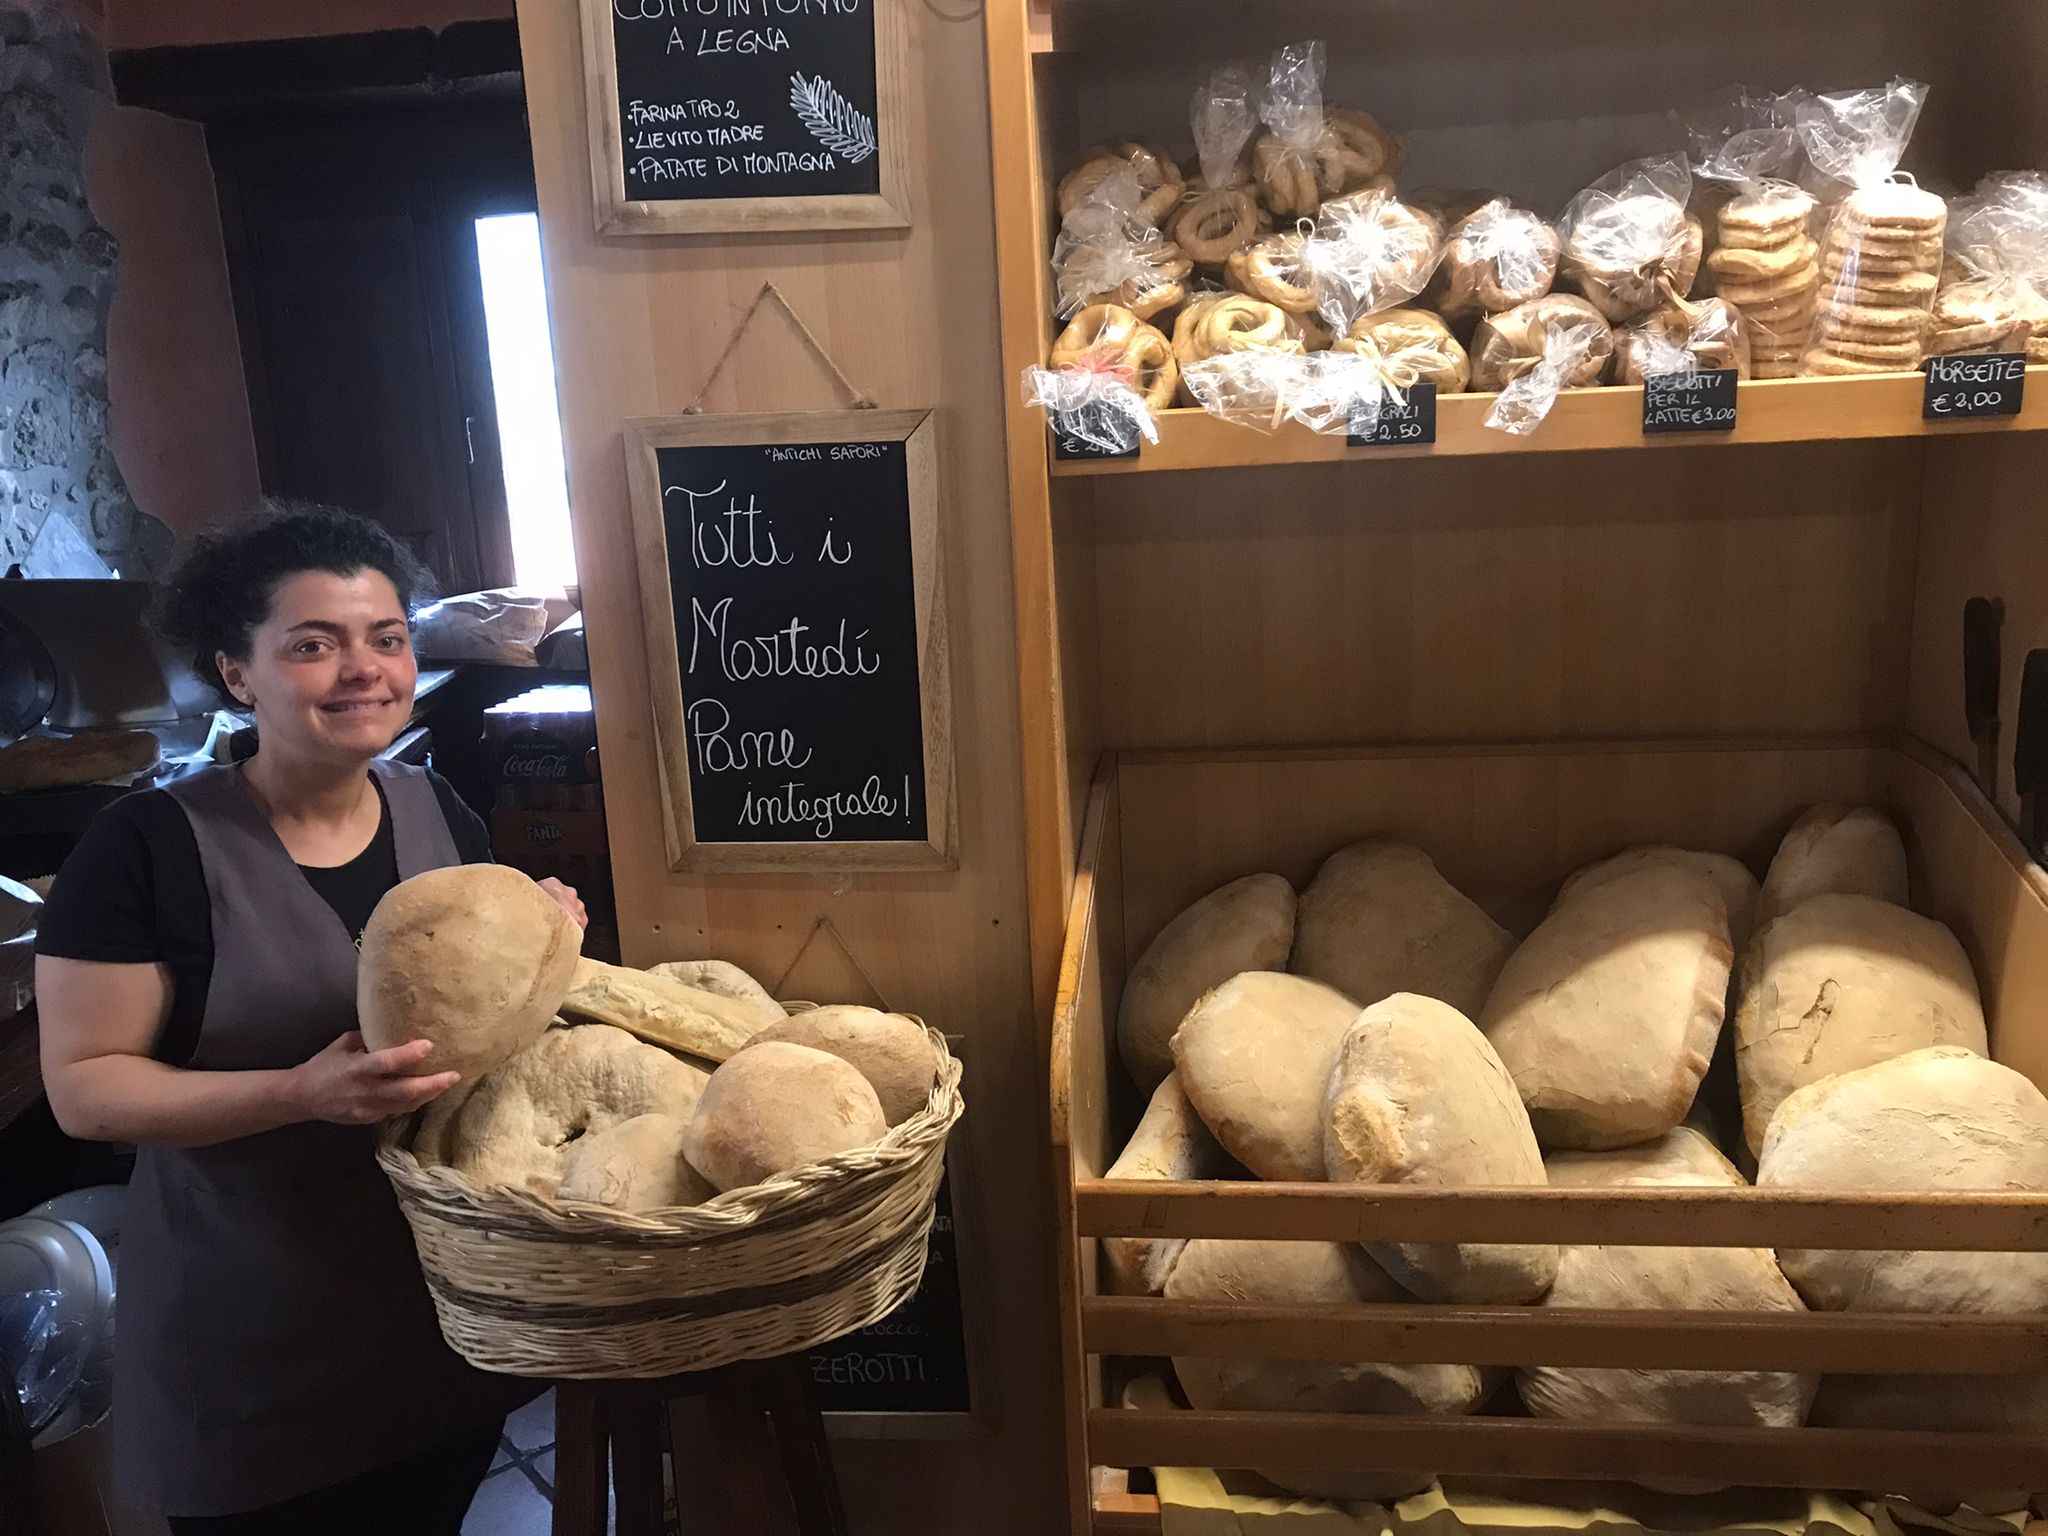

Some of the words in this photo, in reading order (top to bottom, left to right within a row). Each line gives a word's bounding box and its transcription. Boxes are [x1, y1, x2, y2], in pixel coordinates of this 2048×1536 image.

[666, 26, 685, 54] A
[697, 27, 790, 56] LEGNA
[630, 100, 687, 126] FARINA
[686, 99, 722, 119] TIPO
[724, 100, 740, 119] 2
[634, 131, 702, 150] LIEVITO
[707, 125, 764, 146] MADRE
[638, 156, 707, 183] PATATE
[715, 155, 739, 175] DI
[743, 151, 836, 175] MONTAGNA
[1930, 356, 2025, 384] MORSETTE
[1647, 393, 1680, 408] PER
[1686, 393, 1701, 405] IL
[1955, 391, 2001, 410] 2,00
[1644, 407, 1692, 424] LATTE
[1703, 406, 1736, 421] 3.00
[1379, 423, 1422, 440] 2.50
[665, 479, 794, 569] Tutti
[818, 517, 852, 564] i
[688, 699, 812, 775] Pane
[738, 774, 913, 838] integrale!
